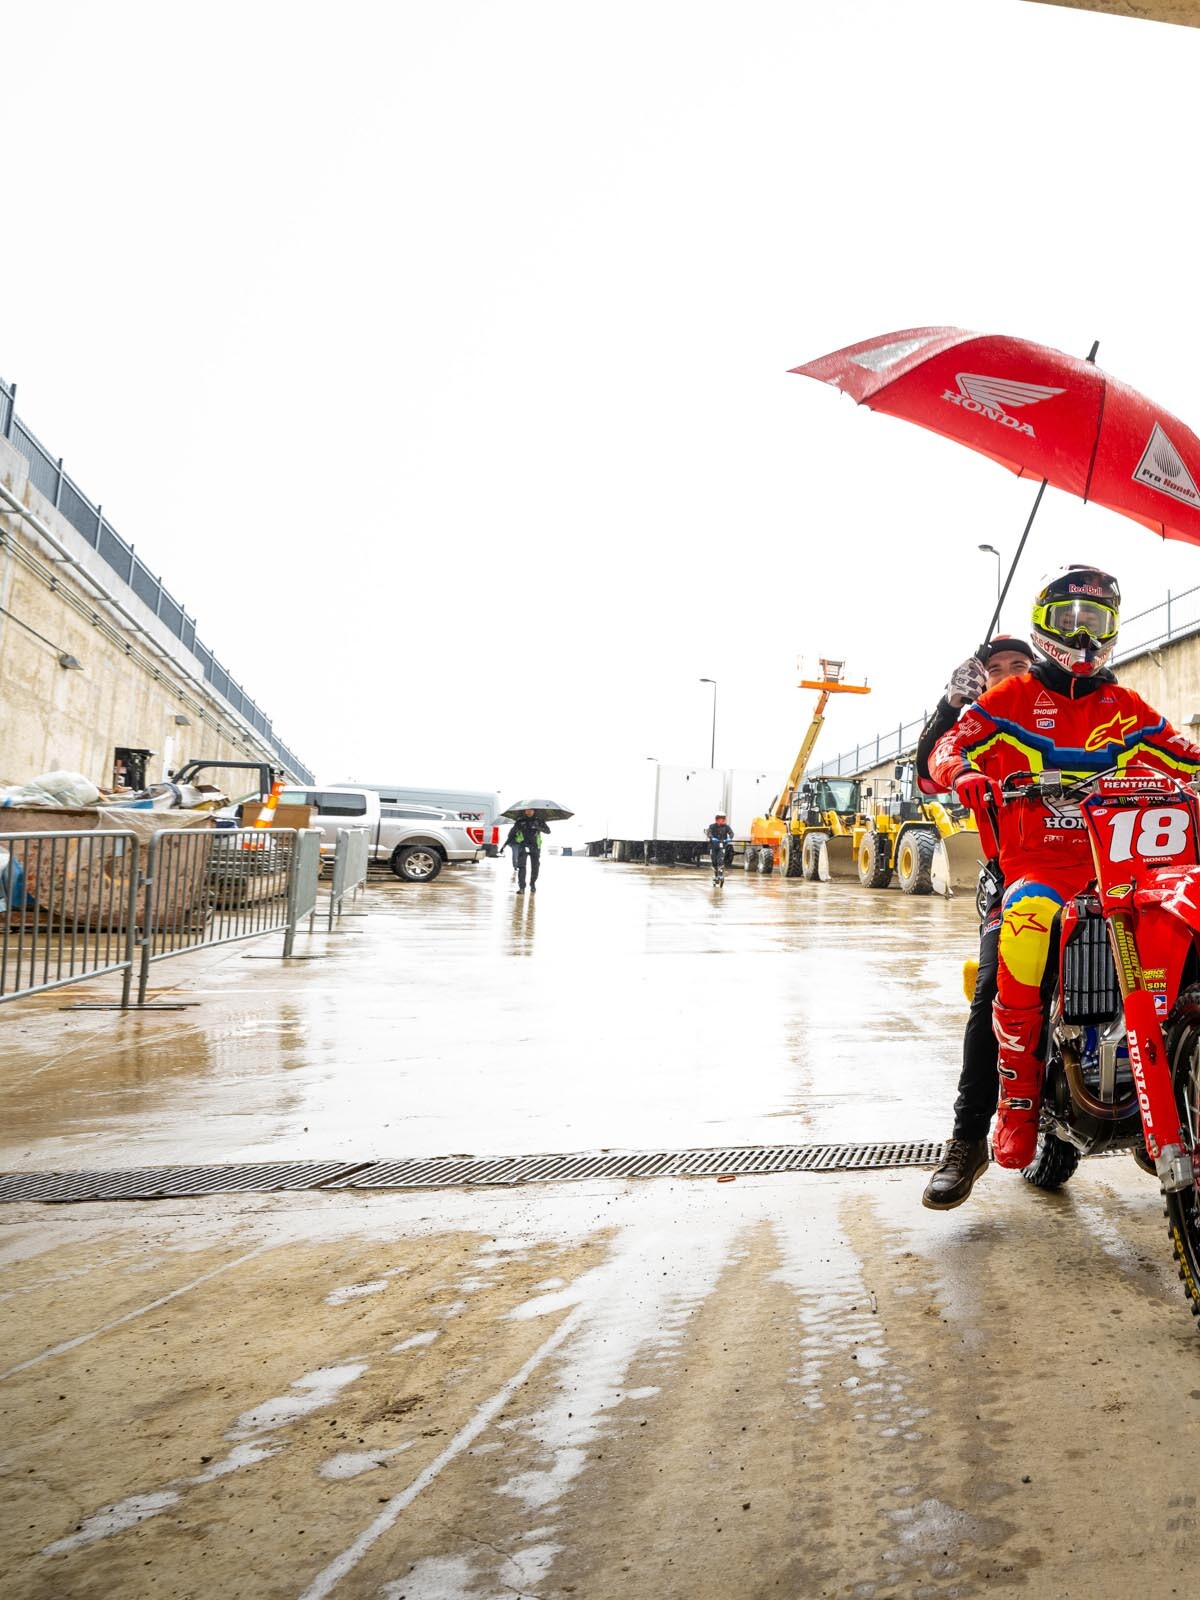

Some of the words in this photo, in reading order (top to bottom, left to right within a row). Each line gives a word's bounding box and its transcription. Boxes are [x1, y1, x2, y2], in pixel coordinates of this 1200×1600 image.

[940, 389, 1036, 439] HONDA
[1141, 469, 1162, 483] Pro
[1162, 478, 1197, 499] Honda
[1068, 583, 1086, 593] Red
[1103, 781, 1166, 789] RENTHAL
[1044, 817, 1088, 829] HON
[1107, 808, 1190, 863] 18
[1127, 1029, 1154, 1128] DUNLOP
